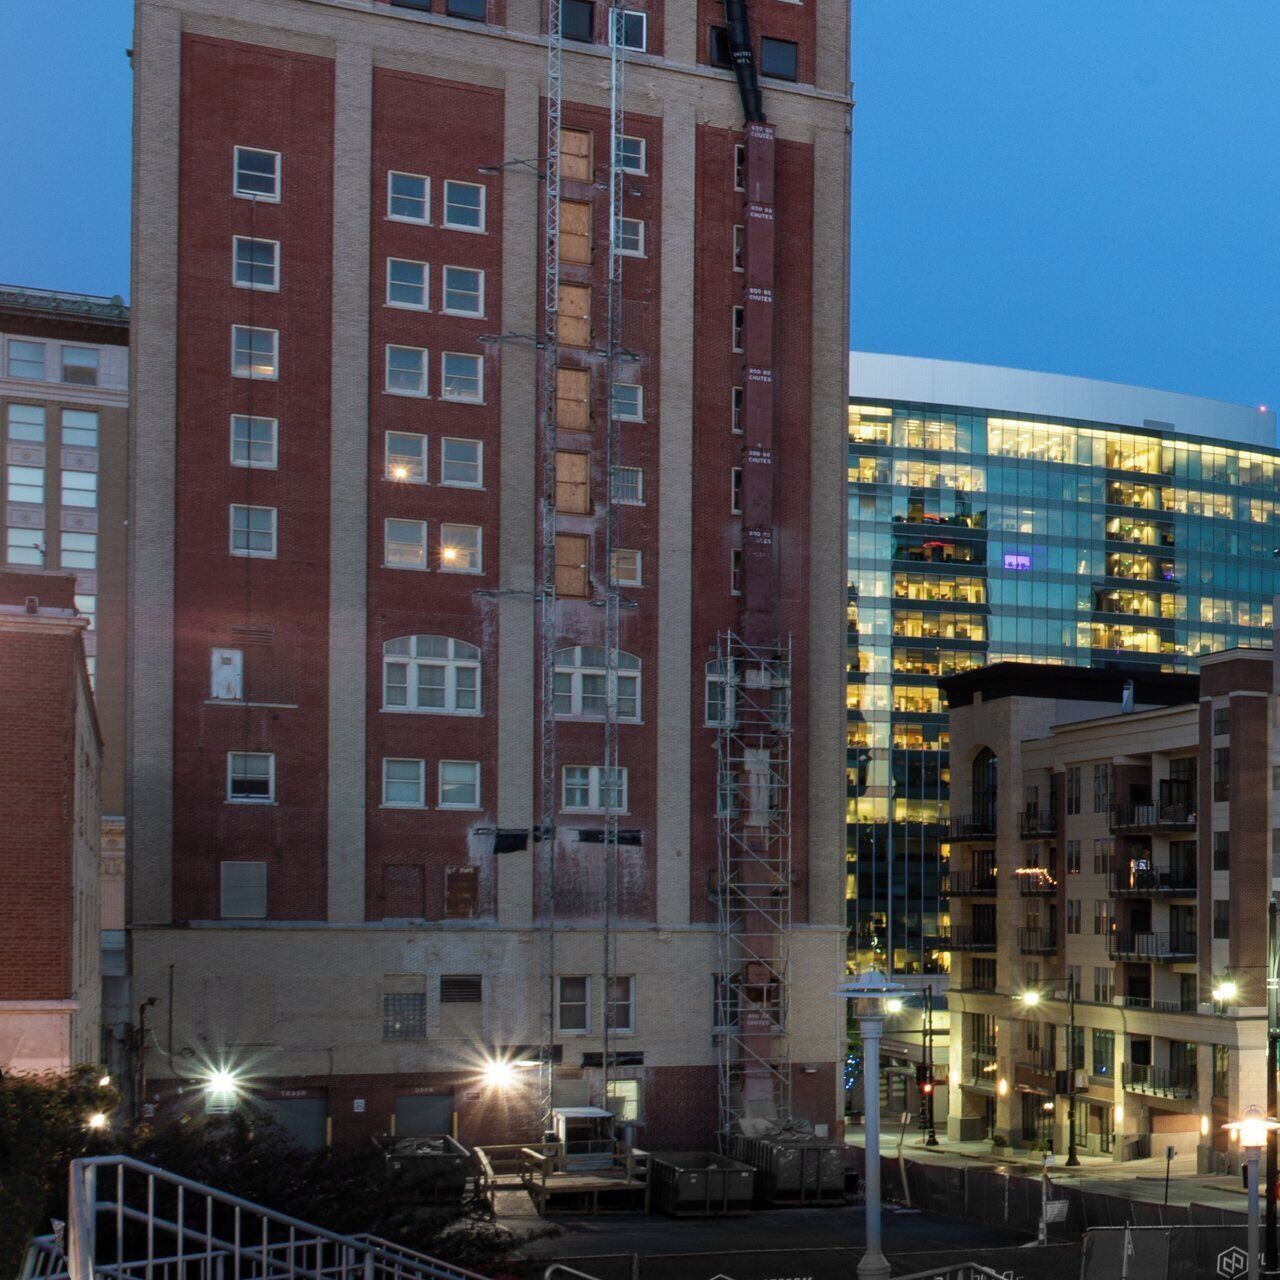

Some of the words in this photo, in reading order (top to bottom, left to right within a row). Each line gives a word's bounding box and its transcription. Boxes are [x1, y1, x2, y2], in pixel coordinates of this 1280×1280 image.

[751, 131, 774, 139] CHUTES
[749, 294, 772, 302] CHUTES
[748, 374, 772, 382] CHUTES
[281, 1089, 307, 1097] TRASH
